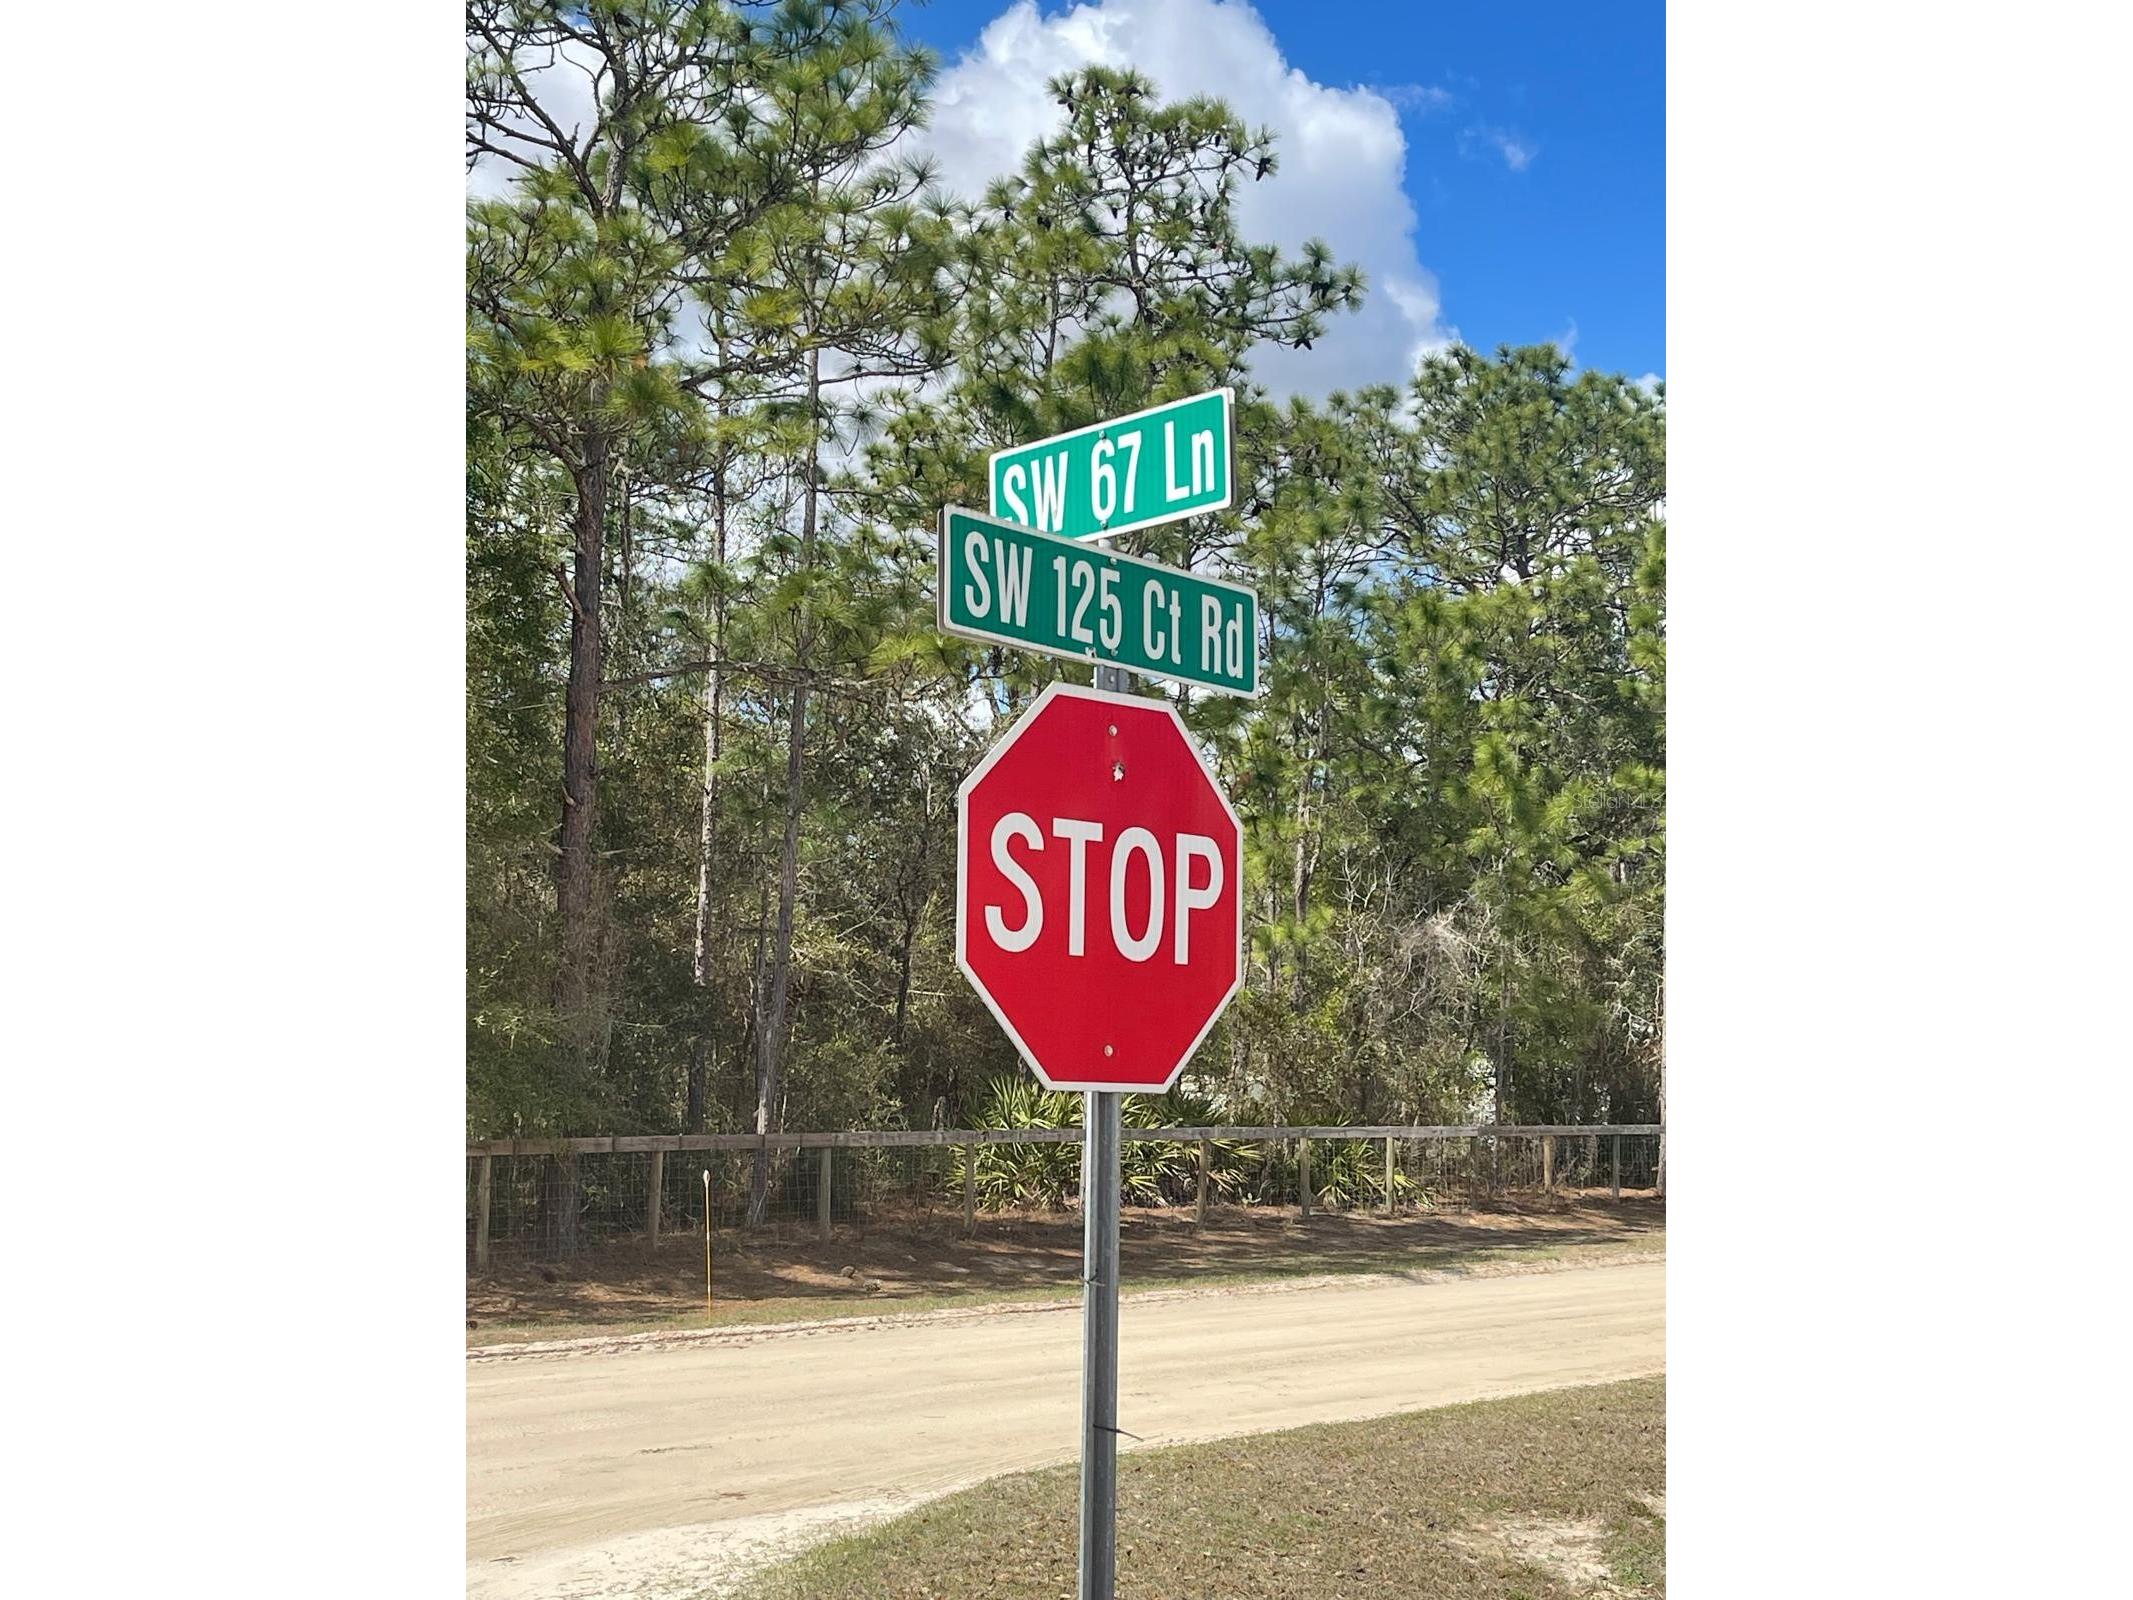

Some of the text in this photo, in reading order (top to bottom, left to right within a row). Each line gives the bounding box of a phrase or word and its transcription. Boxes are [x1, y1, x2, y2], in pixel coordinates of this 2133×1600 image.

[1003, 421, 1215, 532] SW 67 Ln
[965, 531, 1243, 679] SW 125 Ct Rd
[984, 812, 1224, 965] STOP
